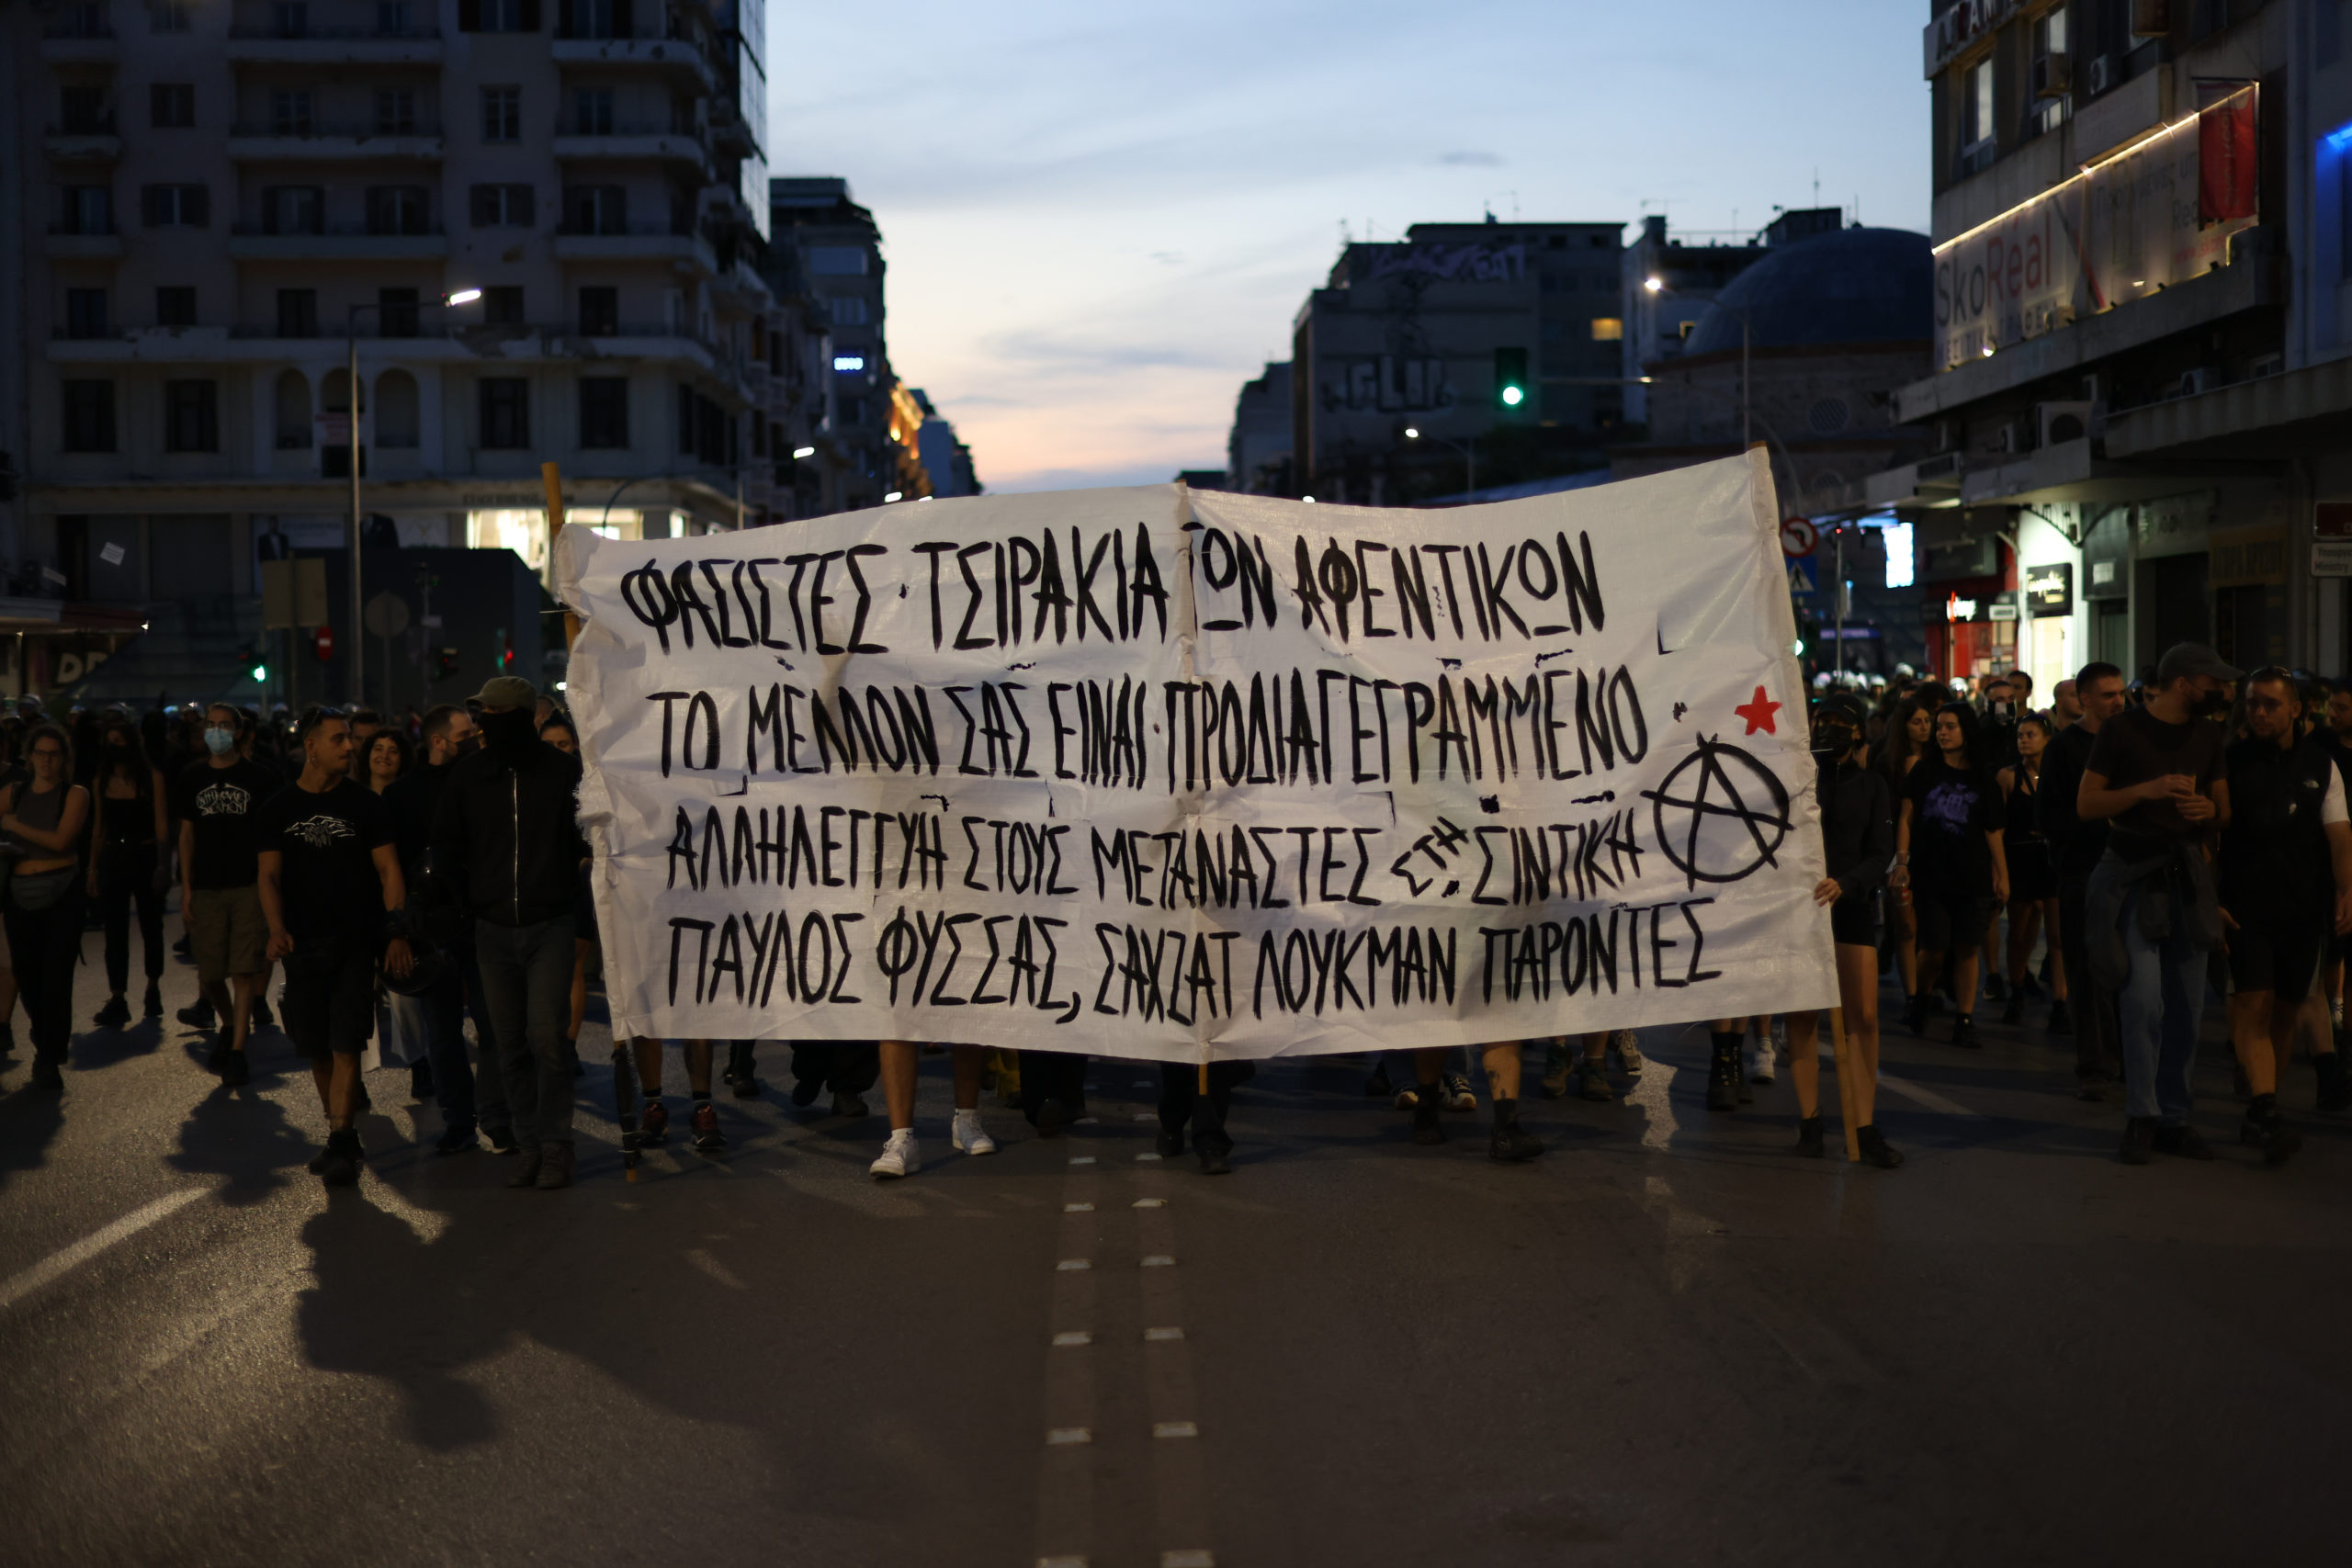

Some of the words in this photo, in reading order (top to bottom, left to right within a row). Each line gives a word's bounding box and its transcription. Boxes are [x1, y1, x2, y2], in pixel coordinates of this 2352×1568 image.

[620, 544, 888, 655] ΦΑΣΙΣΤΕΣ
[911, 521, 1170, 653] ΤΣΙΡΑΚΙΑ
[1291, 529, 1605, 644] ΑΦΕΝΤΙΚΩΝ
[646, 691, 720, 778] ΤΟ
[747, 681, 942, 777] ΜΕΛΛΟΝ
[943, 681, 1040, 778] ΣΑΣ
[1046, 671, 1148, 791] ΕΙΝΑΙ
[1162, 664, 1648, 795] ΠΡΟΔΙΑΓΕΓΡΑΜΜΕΝΟ
[665, 805, 950, 892] ΑΛΛΗΛΕΓΓΥΗ
[960, 816, 1080, 896] ΣΤΟΥΣ
[1090, 826, 1384, 911] ΜΕΤΑΝΑΣΤΕΣ
[1389, 815, 1470, 899] ΣΤΗ
[1471, 807, 1645, 907] ΣΙΝΤΙΚΗ
[668, 908, 867, 1009] ΠΑΥΛΟΣ
[876, 905, 1083, 1025] ΦΥΣΣΑΣ,
[1091, 921, 1241, 1027] ΣΑΧΖΑΤ
[1253, 925, 1457, 1021] ΛΟΥΚΜΑΝ
[1477, 897, 1723, 1007] ΠΑΡΟΝΤΕΣ
